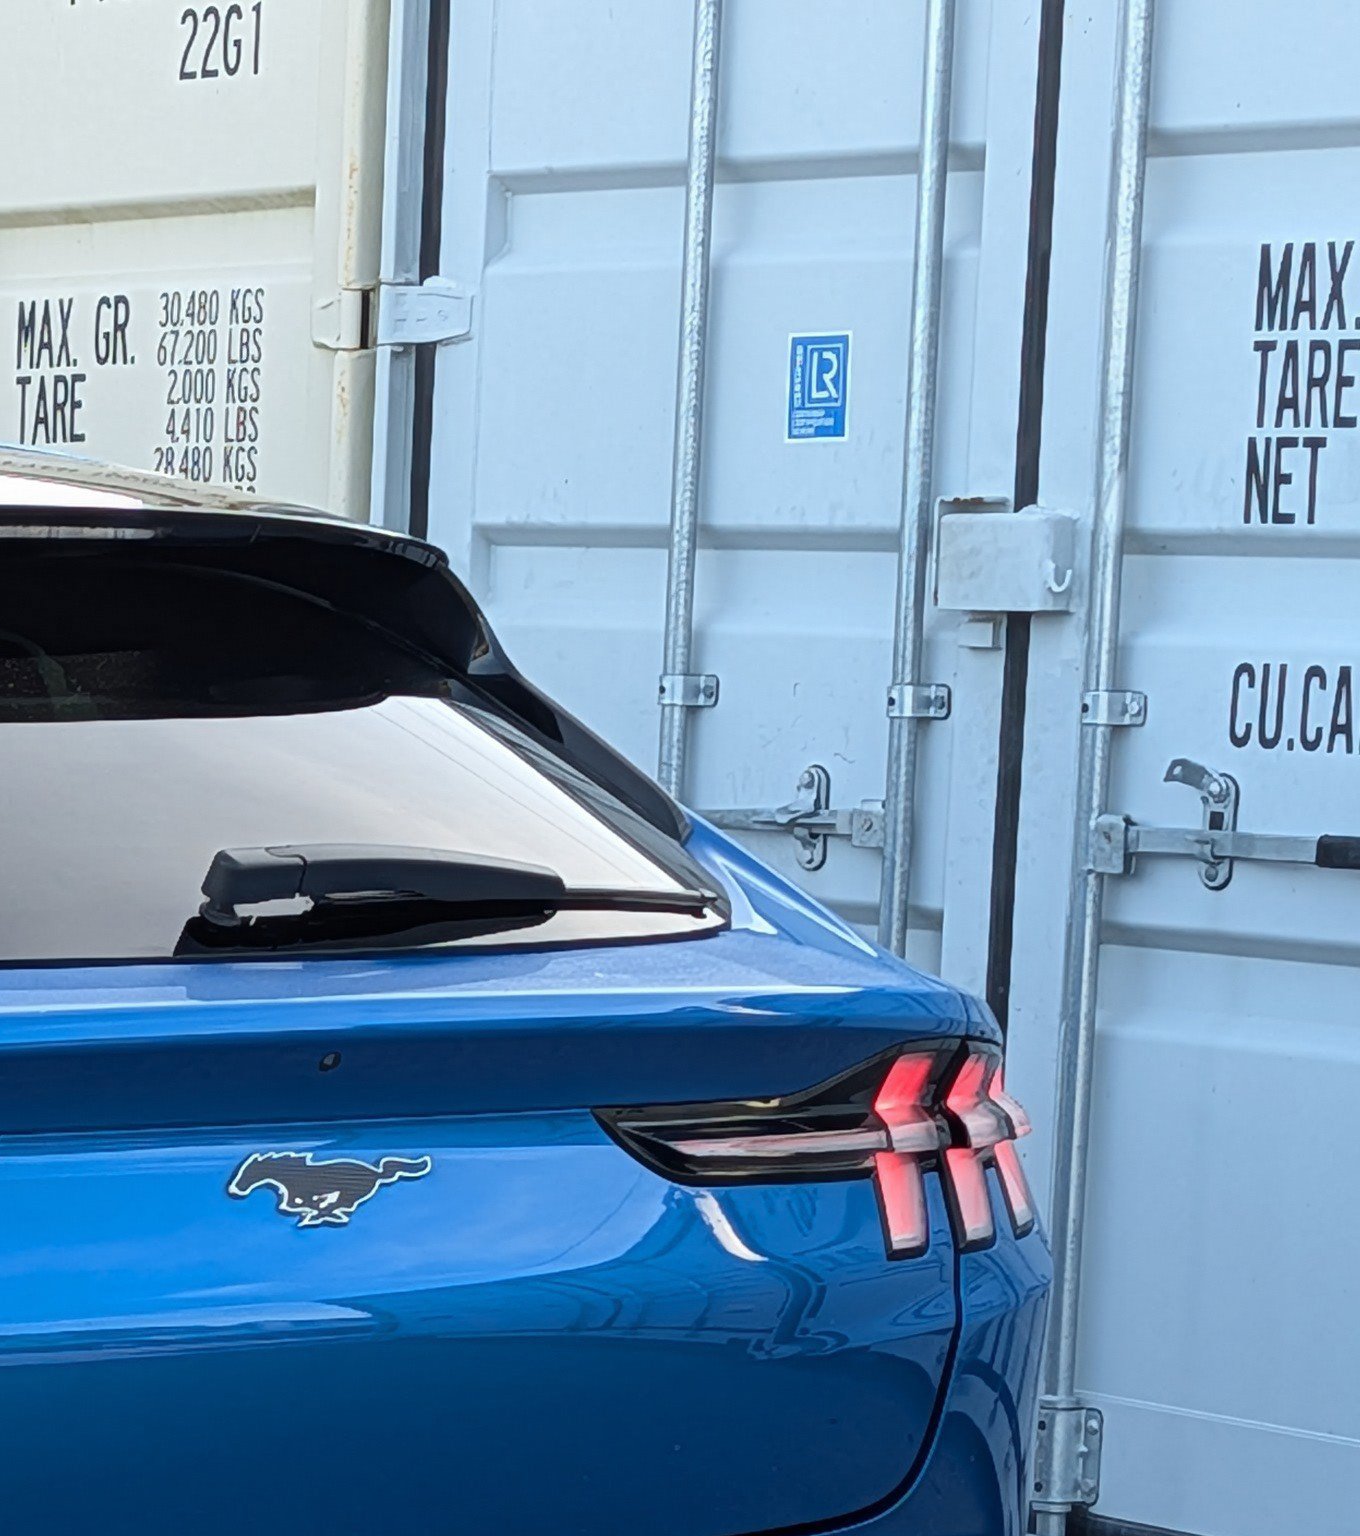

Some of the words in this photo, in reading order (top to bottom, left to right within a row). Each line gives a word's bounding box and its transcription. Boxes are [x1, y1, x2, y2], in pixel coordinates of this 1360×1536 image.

[179, 1, 262, 80] 22G1
[16, 297, 78, 370] MAX.
[95, 294, 136, 366] GR.
[229, 287, 265, 326] KGS
[227, 327, 263, 365] LBS
[15, 373, 87, 446] TARE
[225, 366, 261, 404] KGS
[1253, 338, 1360, 429] TARE
[224, 406, 259, 443] LBS
[223, 445, 259, 483] KGS
[1243, 436, 1328, 526] NET
[1227, 661, 1360, 755] CU.CA
